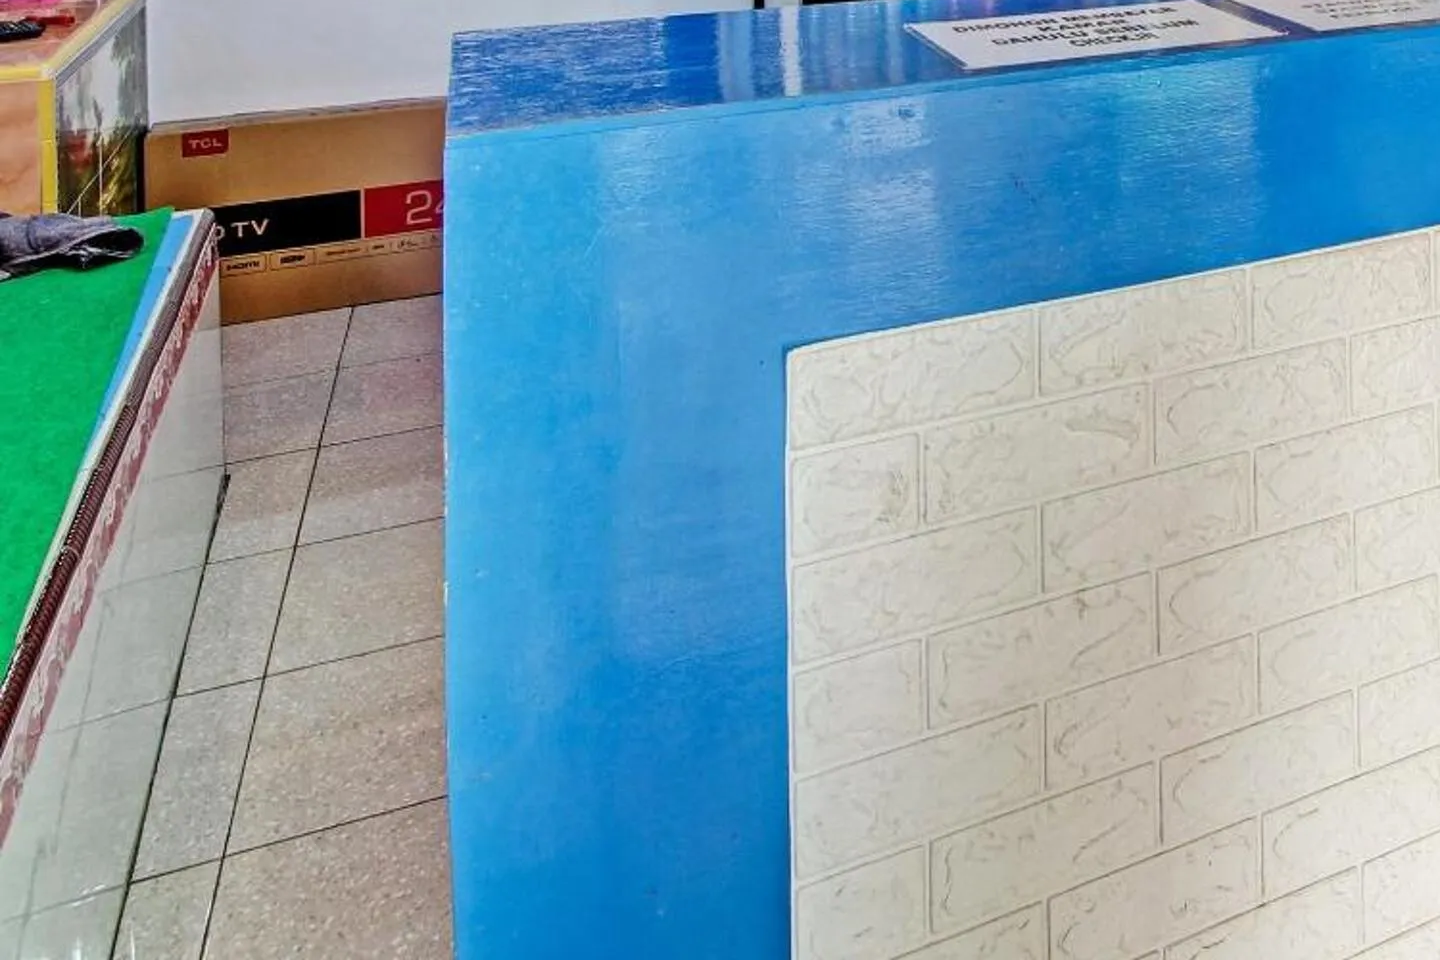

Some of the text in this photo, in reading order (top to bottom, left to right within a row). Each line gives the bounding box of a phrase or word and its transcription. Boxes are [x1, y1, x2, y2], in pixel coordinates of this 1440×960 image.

[953, 17, 1057, 33] DIMOHON
[1038, 19, 1129, 32] KAMAR
[991, 30, 1090, 46] DAHULU
[187, 137, 223, 150] TCL
[230, 218, 270, 238] TV
